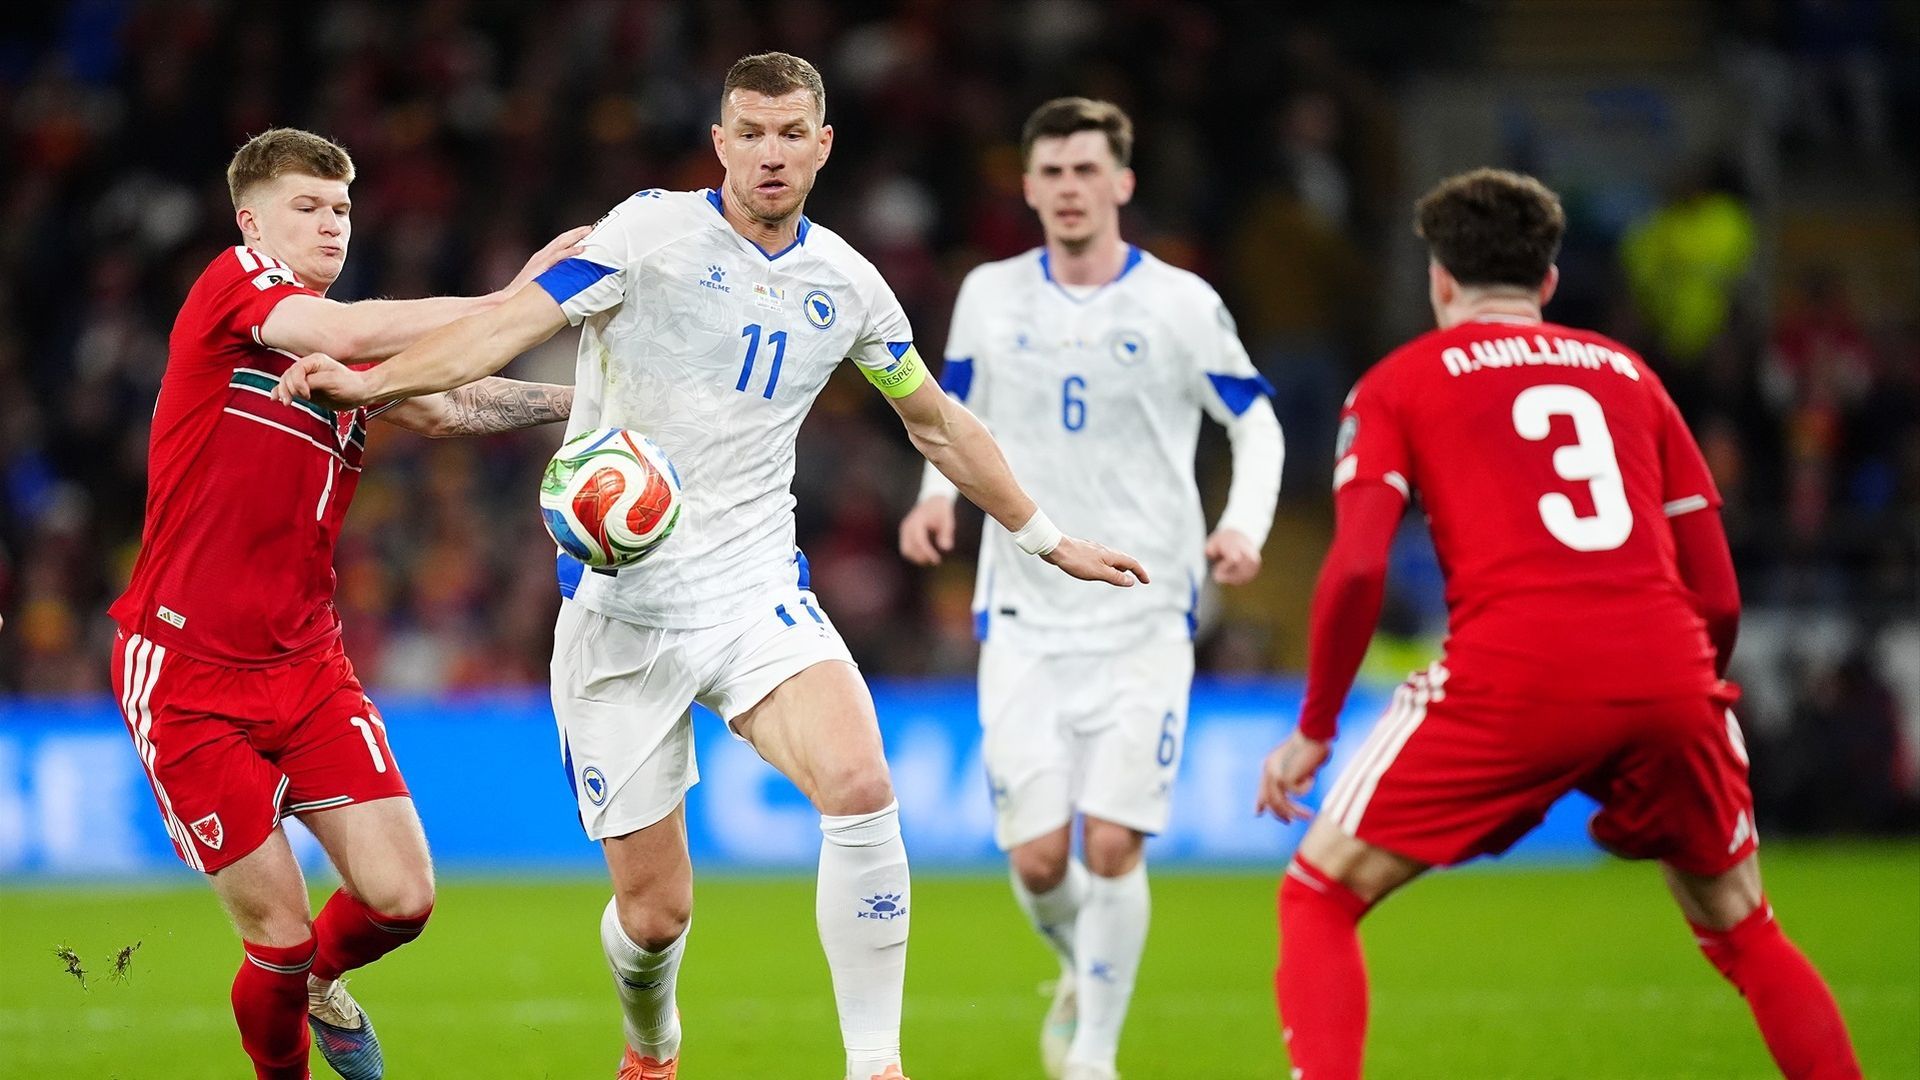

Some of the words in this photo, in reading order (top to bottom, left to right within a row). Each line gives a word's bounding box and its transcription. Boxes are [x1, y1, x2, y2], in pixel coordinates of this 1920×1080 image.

[699, 280, 731, 294] KELME
[735, 323, 788, 400] 11
[1062, 375, 1087, 433] 6
[1511, 383, 1634, 552] 3
[1157, 711, 1178, 767] 6
[857, 907, 907, 919] KELME
